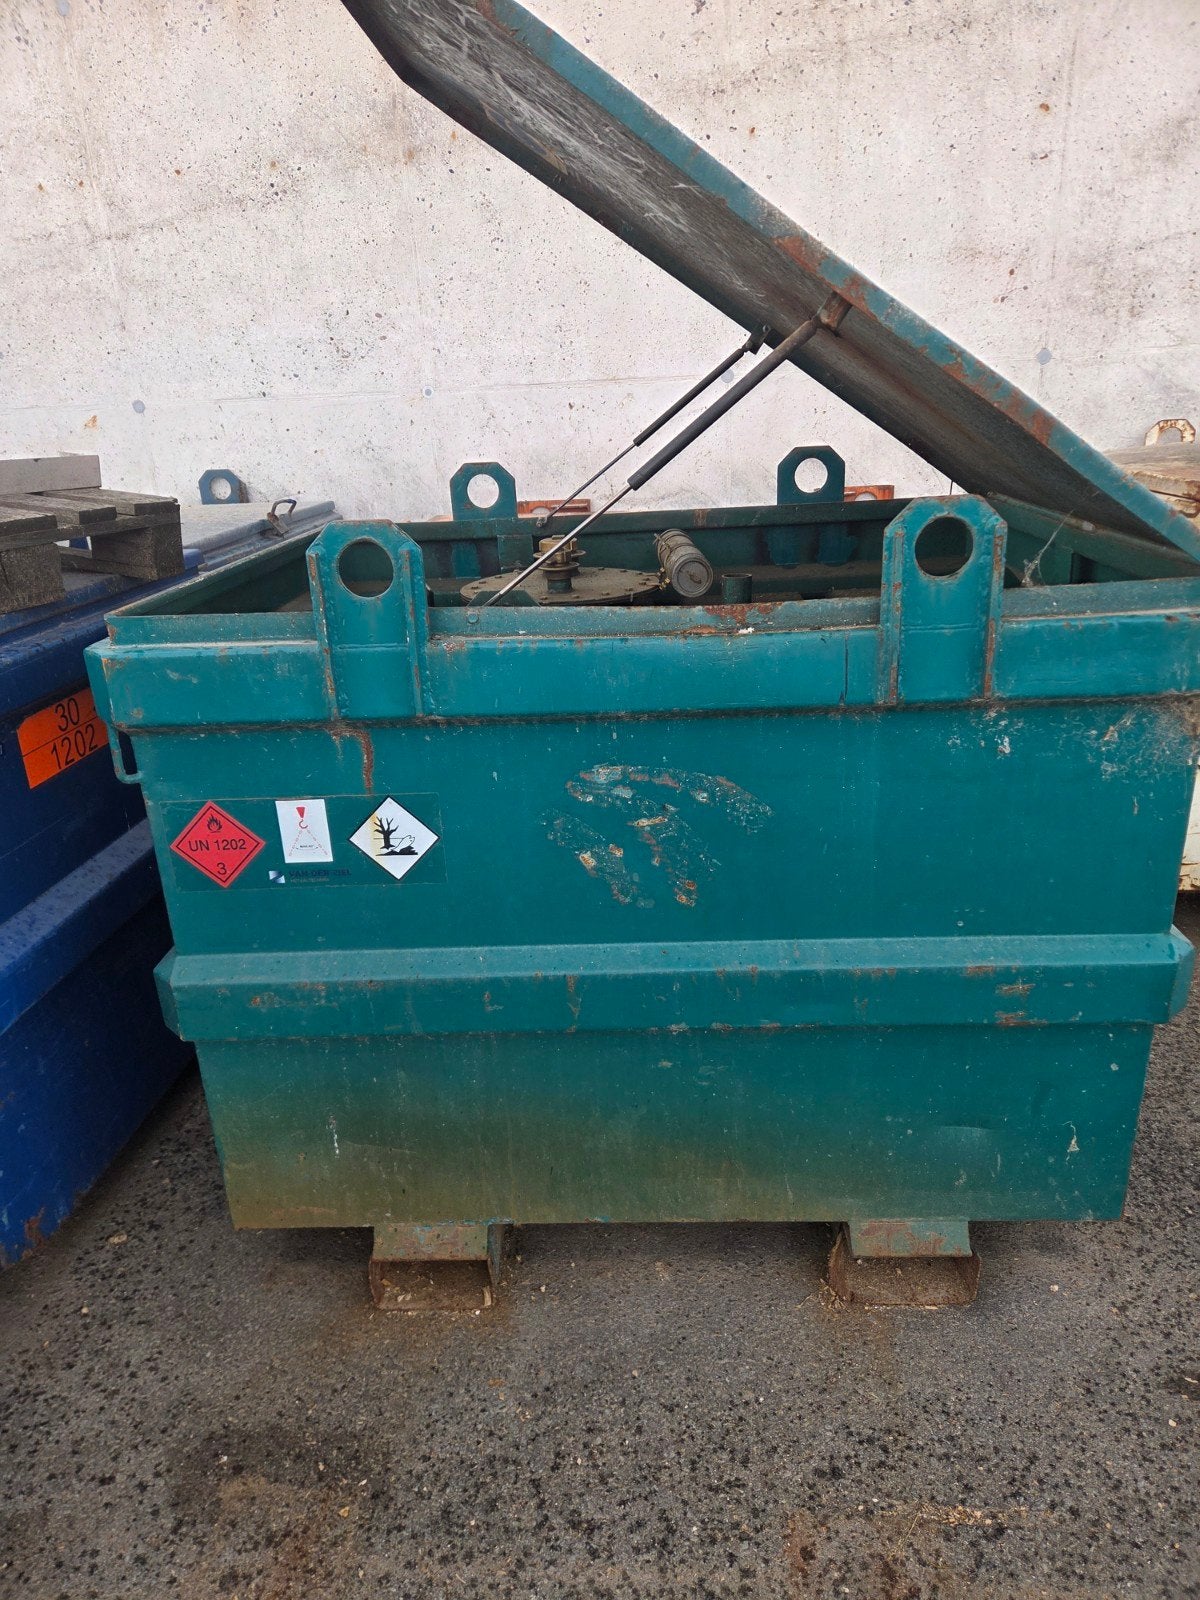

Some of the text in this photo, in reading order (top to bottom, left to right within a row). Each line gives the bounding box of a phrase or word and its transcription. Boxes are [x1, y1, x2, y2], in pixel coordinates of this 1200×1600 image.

[54, 697, 80, 732] 30
[51, 723, 98, 769] 1202
[188, 838, 247, 852] UN 1202
[216, 862, 227, 875] 3
